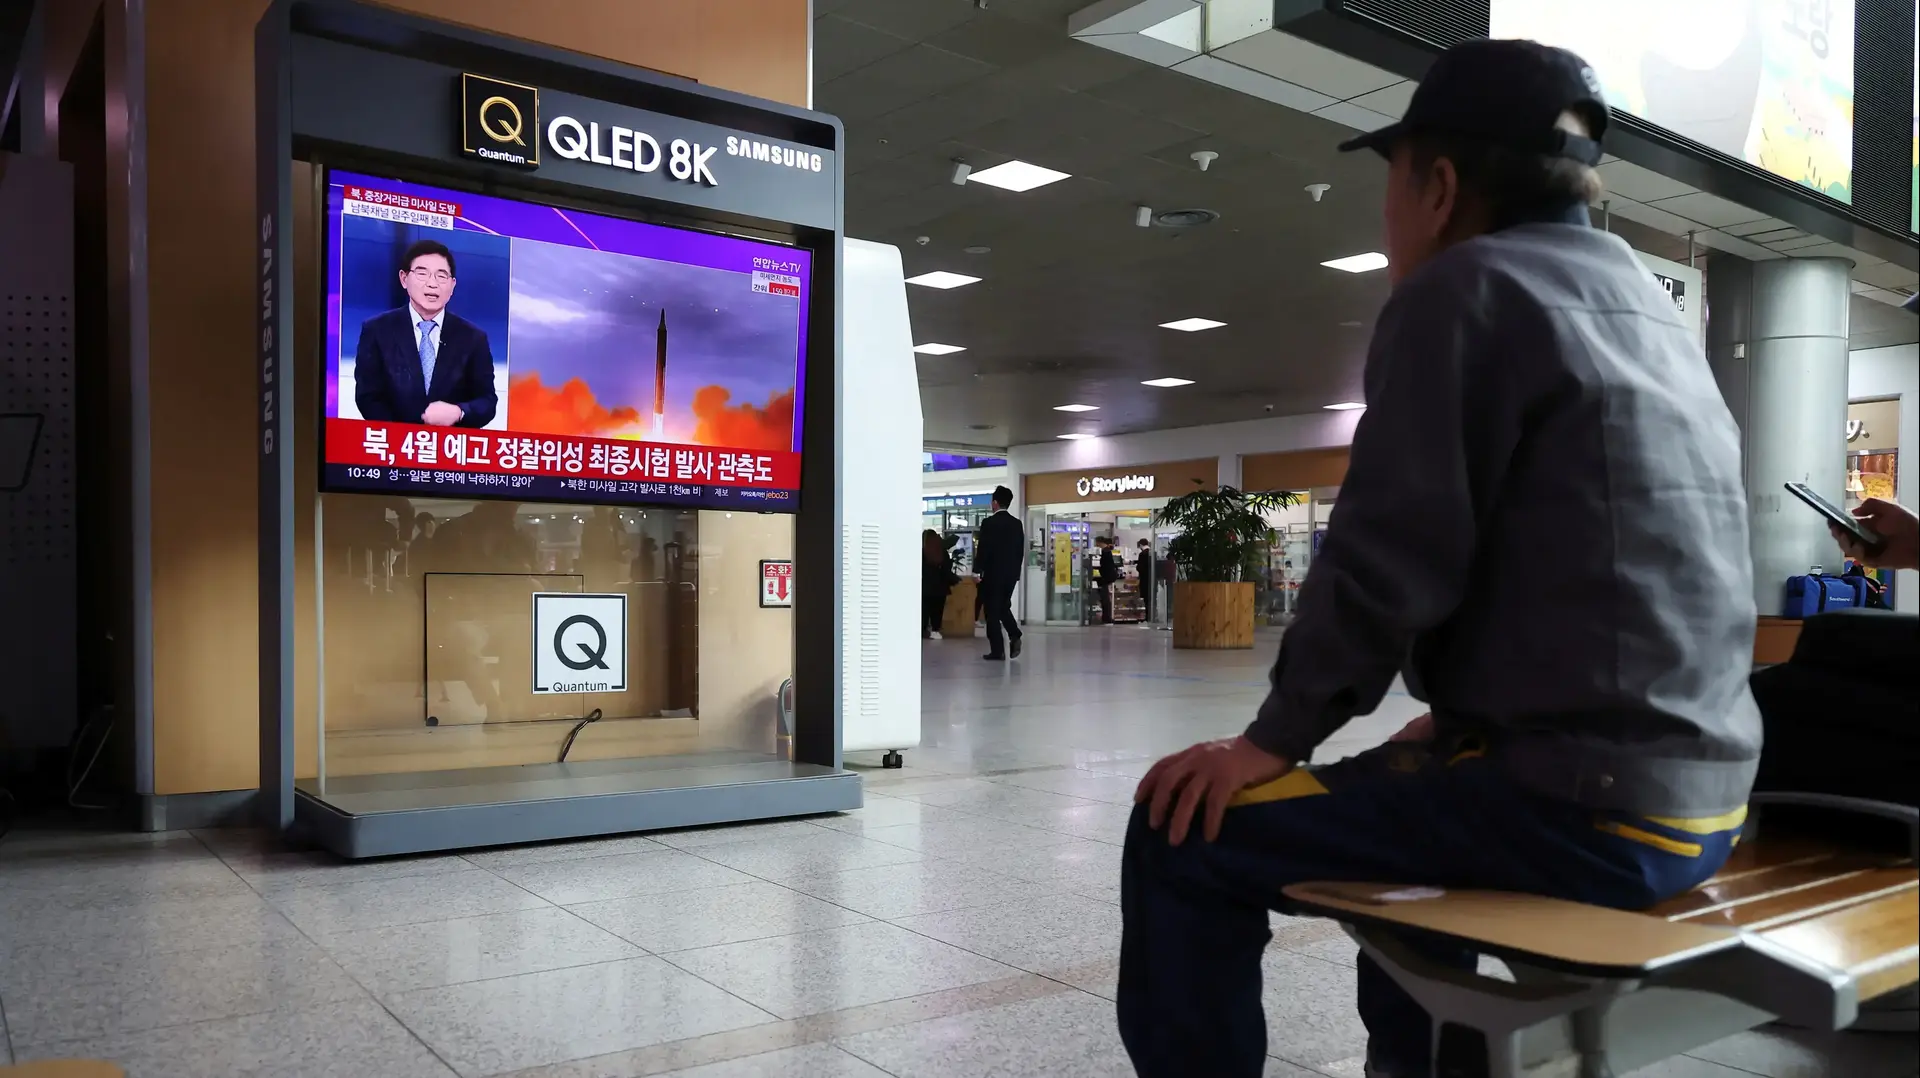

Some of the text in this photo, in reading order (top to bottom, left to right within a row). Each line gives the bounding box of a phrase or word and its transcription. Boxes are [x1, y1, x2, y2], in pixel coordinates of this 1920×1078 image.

[479, 96, 526, 147] Q
[478, 147, 525, 164] Quantum
[547, 116, 718, 187] QLED 8K
[726, 136, 822, 172] SAMSUNG
[351, 202, 389, 219] 남북채널
[411, 198, 437, 212] 미사일
[438, 203, 456, 215] 도발
[753, 257, 801, 273] 연합뉴스TV
[262, 213, 273, 454] SAMSUNG
[363, 427, 773, 483] 북, 4월 예고 정찰위성 최종시험 발사 관측도
[347, 467, 381, 479] 10:49
[433, 472, 465, 485] 영역에
[468, 474, 509, 487] 낙하하지
[567, 479, 588, 492] 북한
[589, 480, 617, 494] 미사일
[618, 482, 637, 494] 고각
[640, 485, 667, 496] 발사로
[1091, 474, 1155, 493] StoryWay
[714, 487, 729, 498] 제보
[554, 614, 610, 671] Q
[553, 681, 608, 693] Quantum
